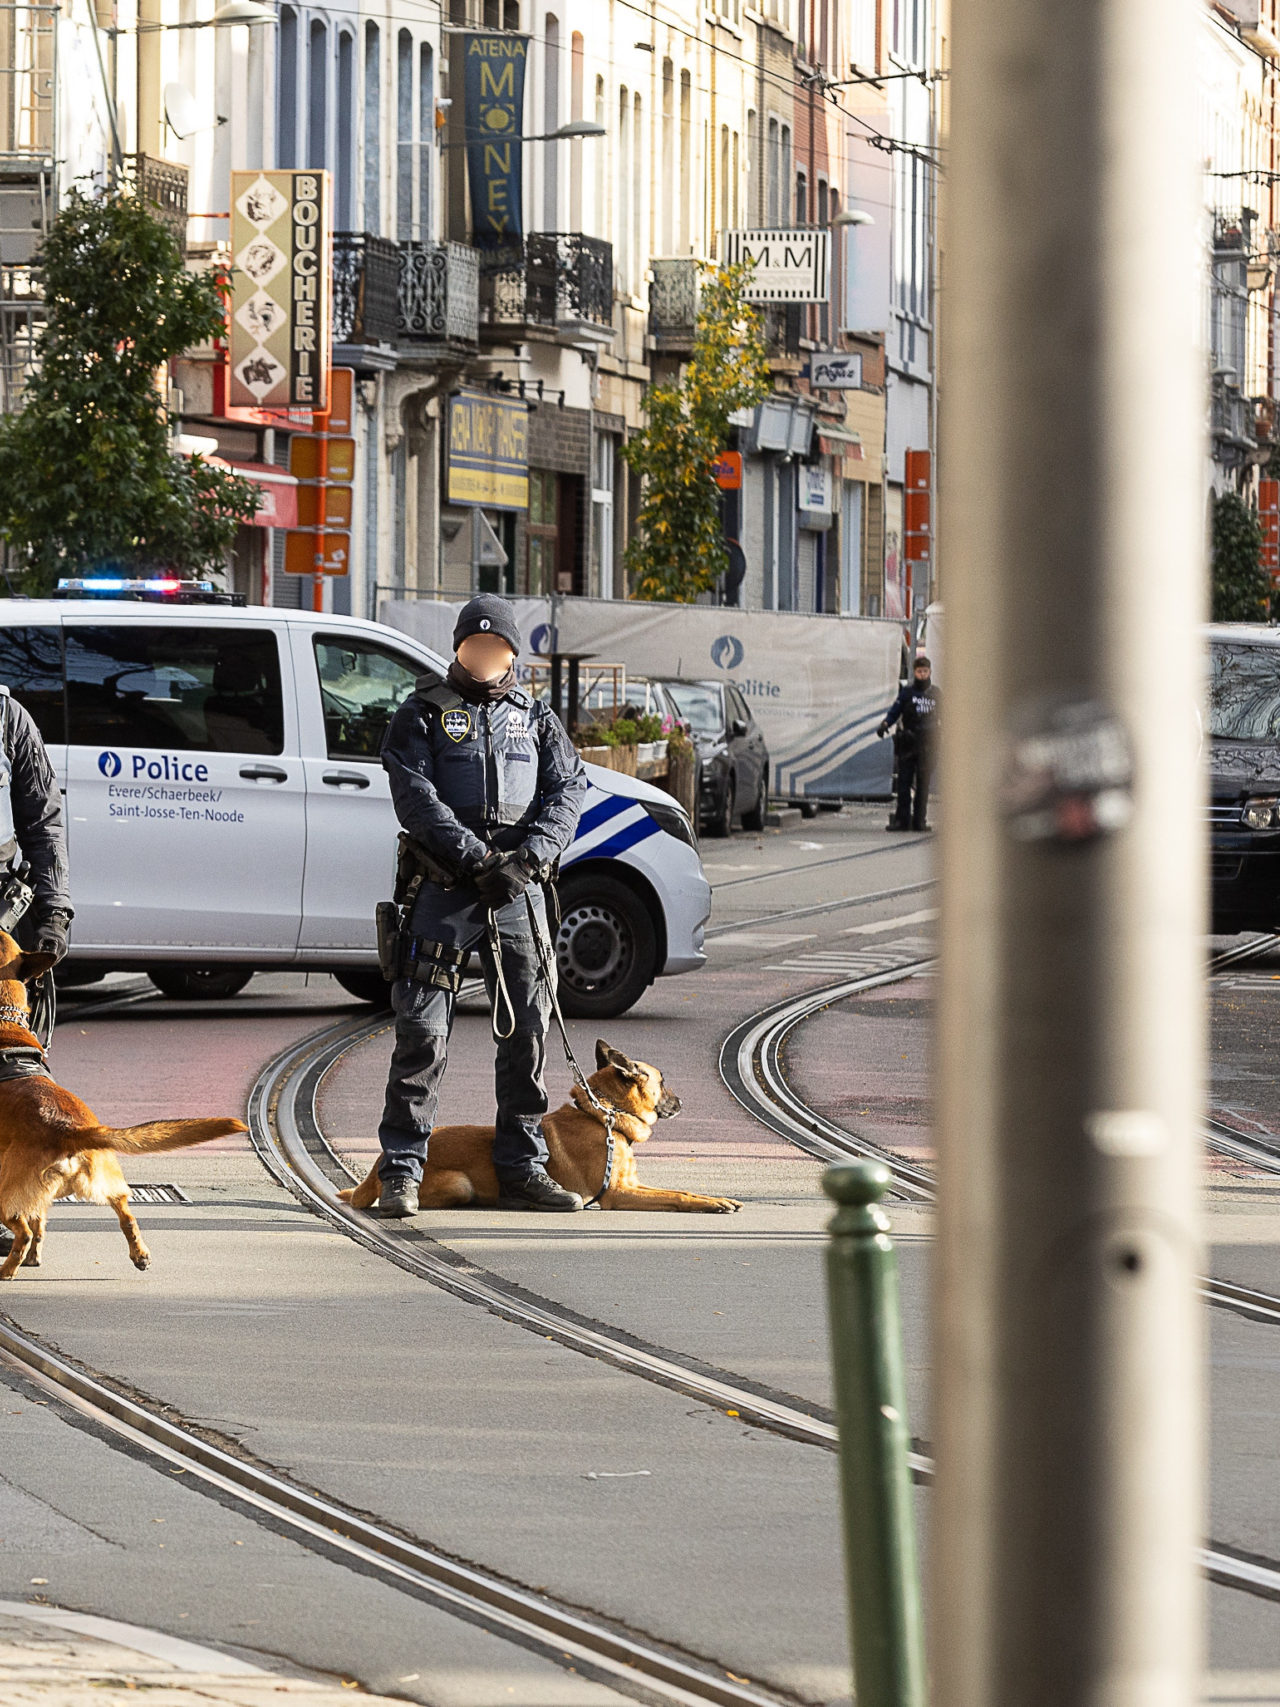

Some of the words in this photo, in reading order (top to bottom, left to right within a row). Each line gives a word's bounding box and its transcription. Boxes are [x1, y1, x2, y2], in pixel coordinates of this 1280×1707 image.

[469, 38, 526, 58] ATENA
[742, 246, 769, 268] M
[784, 246, 812, 268] M
[293, 175, 319, 401] BOUCHERIE
[132, 755, 208, 782] Police
[108, 785, 223, 803] Evere/Schaerbeek/
[109, 804, 245, 823] Saint-Josse-Ten-Noode
